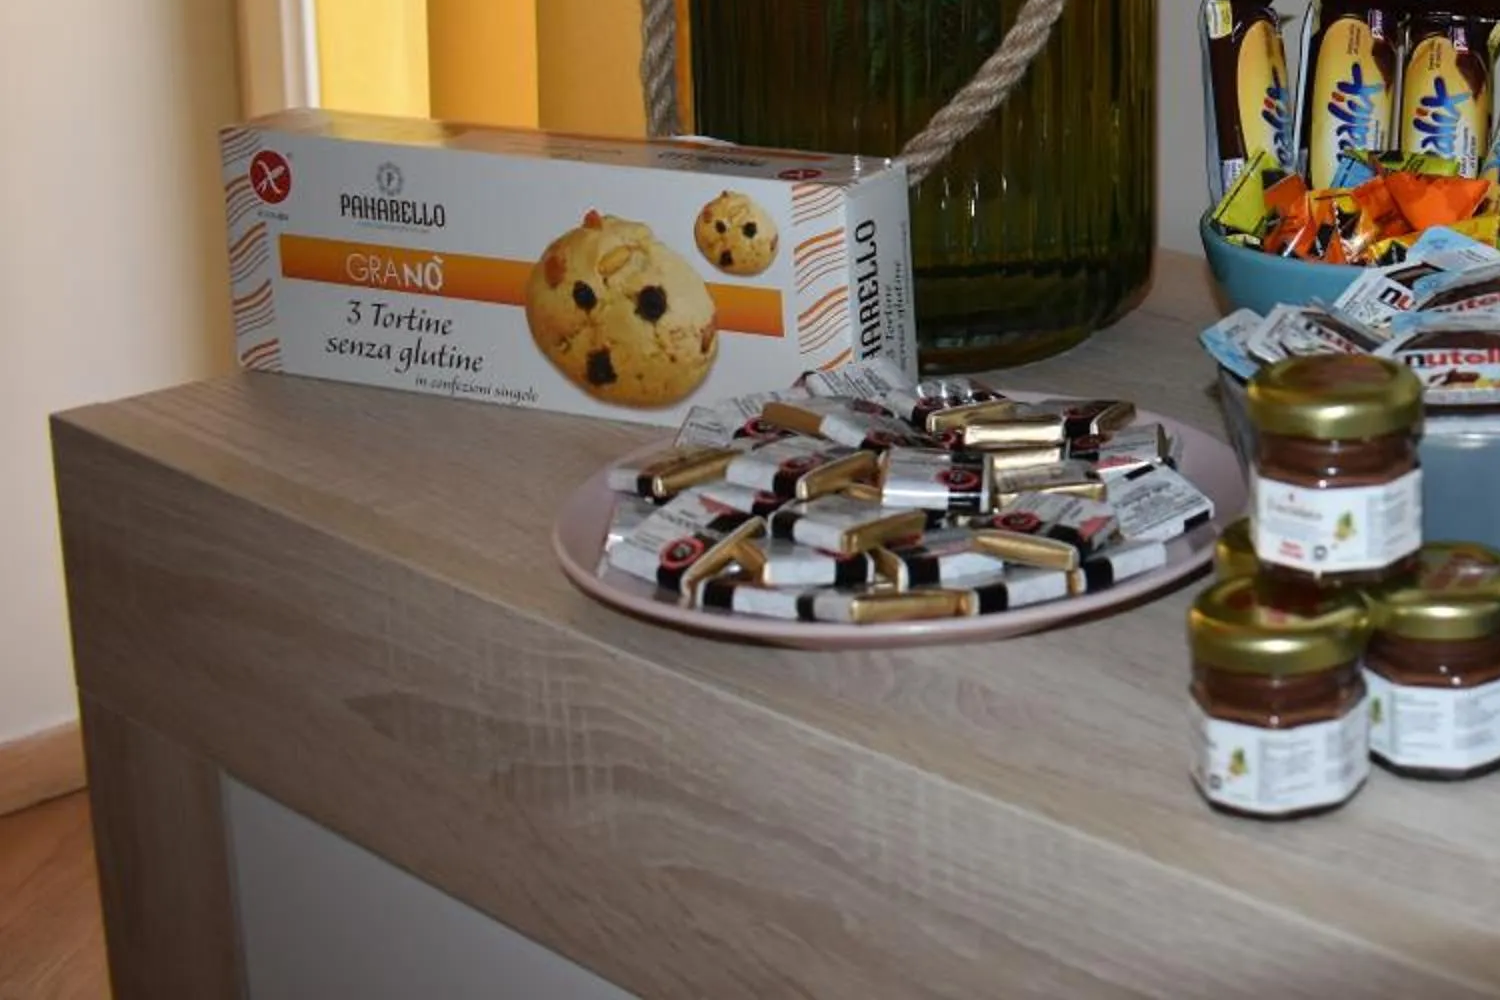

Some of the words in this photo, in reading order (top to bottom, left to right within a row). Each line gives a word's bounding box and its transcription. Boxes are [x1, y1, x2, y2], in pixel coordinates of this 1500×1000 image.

[345, 252, 445, 292] GRANÒ
[346, 299, 363, 325] 3
[371, 302, 454, 336] Tortine
[324, 336, 392, 361] senza
[394, 339, 485, 374] glutine
